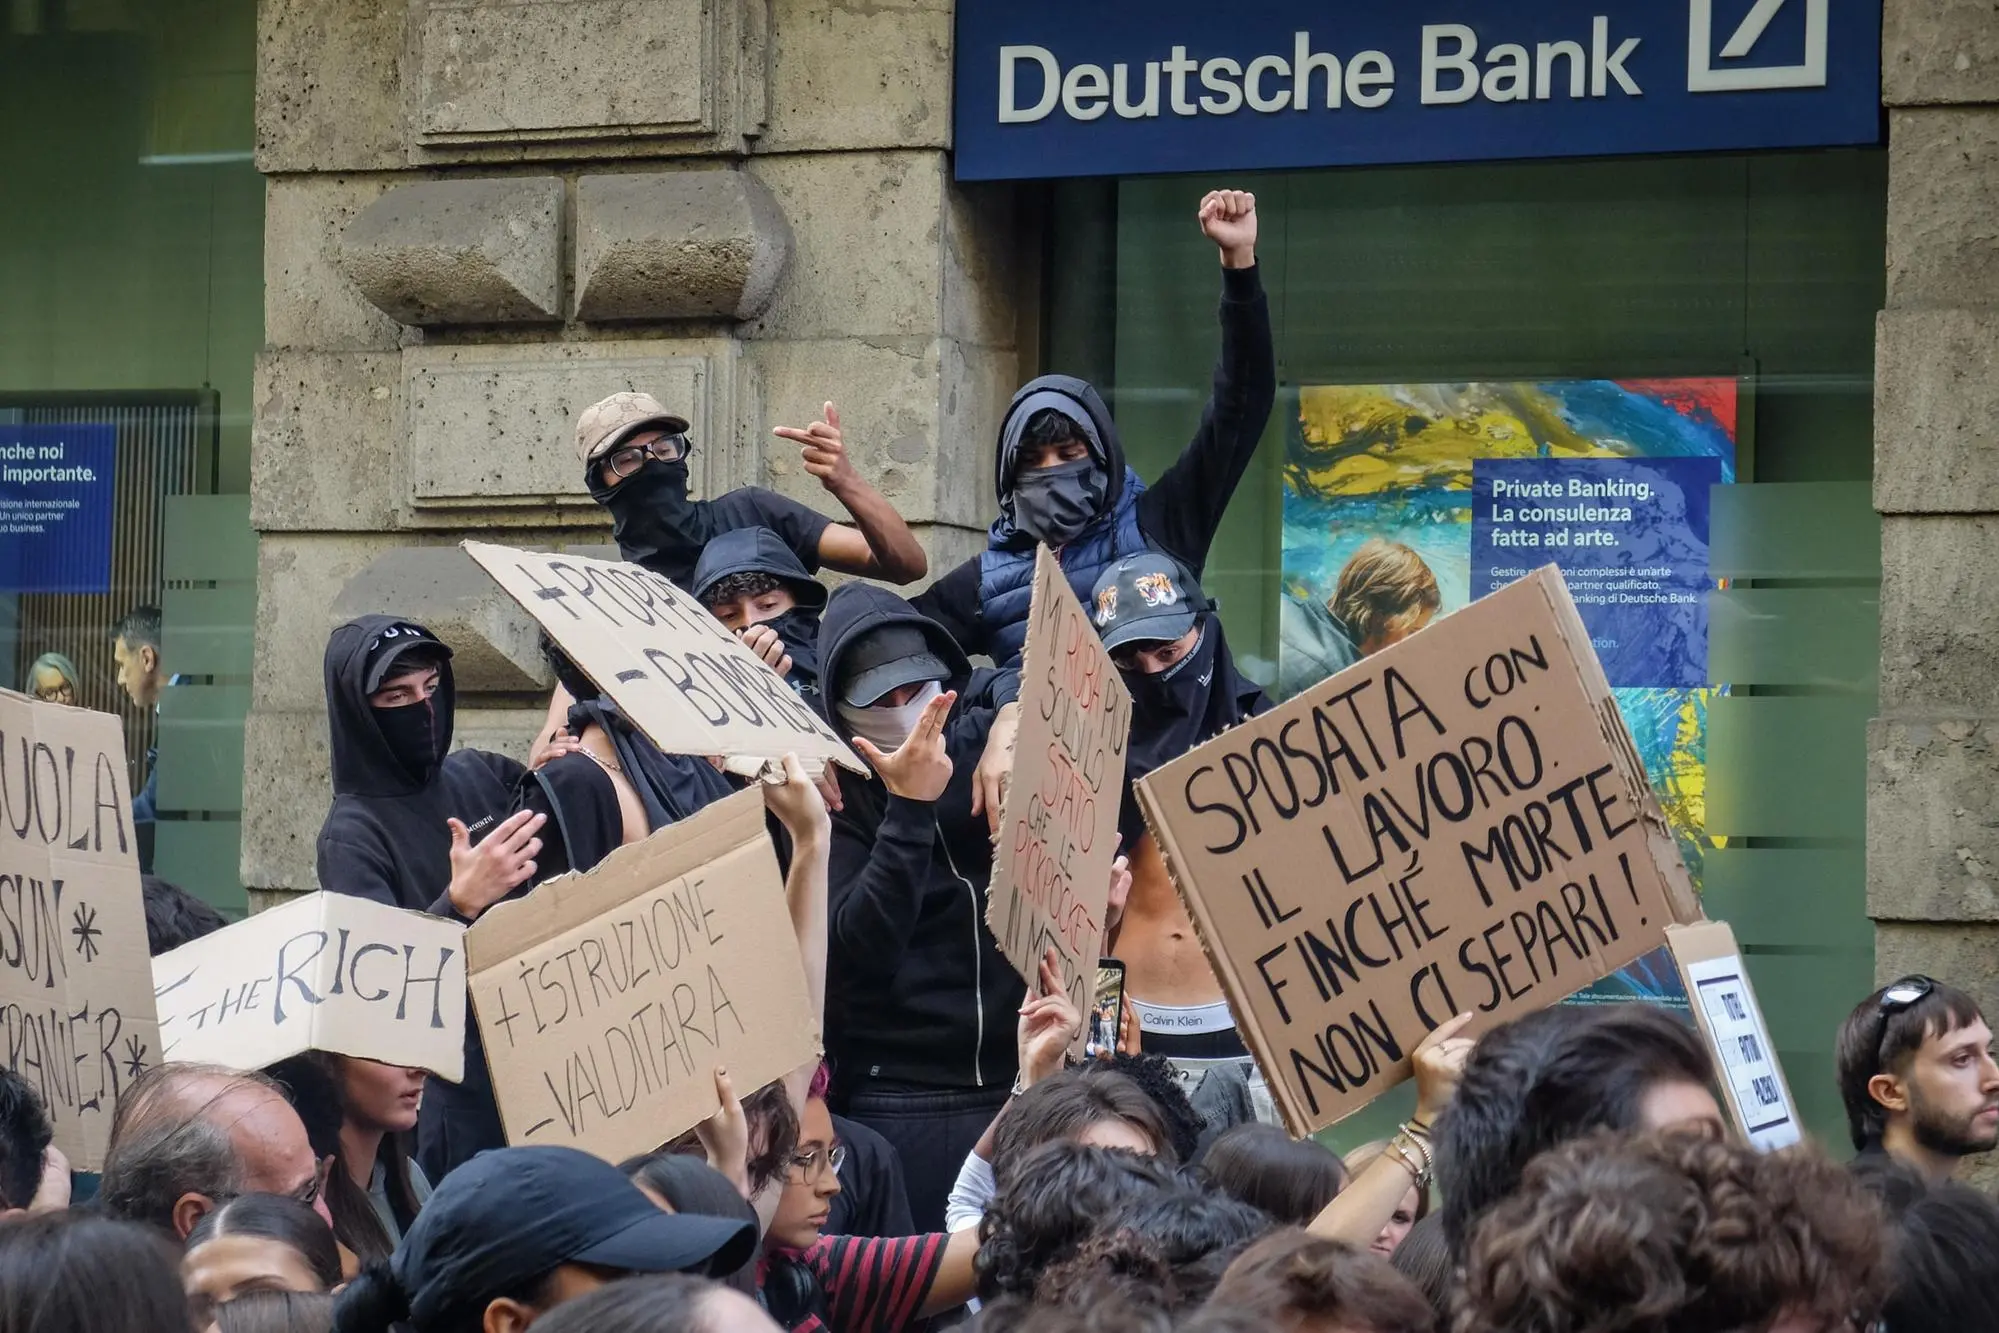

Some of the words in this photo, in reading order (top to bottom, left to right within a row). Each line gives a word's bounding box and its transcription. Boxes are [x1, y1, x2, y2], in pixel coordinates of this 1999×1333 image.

[998, 31, 1394, 123] Deutsche
[1420, 15, 1643, 105] Bank
[3, 465, 97, 485] importante.
[39, 442, 64, 460] noi
[12, 511, 34, 521] unico
[35, 512, 65, 522] partner
[25, 498, 80, 509] internazionale
[1492, 478, 1563, 498] Private
[1568, 478, 1655, 501] Banking.
[1492, 503, 1514, 522] La
[1518, 503, 1632, 522] consulenza
[1491, 528, 1540, 547] fatta
[1544, 528, 1569, 547] ad
[1573, 529, 1620, 547] arte.
[1490, 566, 1527, 577] Gestire
[1577, 566, 1628, 580] complessi
[1567, 581, 1604, 592] partner
[1606, 580, 1661, 592] qualificato.
[1607, 593, 1618, 604] di
[1619, 593, 1668, 604] Deutsche
[1670, 593, 1698, 604] Bank.
[1039, 573, 1063, 660] MI
[641, 648, 841, 744] BOMBE
[1083, 728, 1105, 794] LO
[1185, 666, 1447, 855] SPOSATA
[1464, 634, 1549, 709] CON
[0, 730, 128, 854] UOLA
[1041, 742, 1096, 853] STATO
[1027, 793, 1053, 845] CHE
[1058, 833, 1076, 881] LE
[1460, 763, 1638, 909] MORTE
[1005, 884, 1024, 955] IN
[1011, 819, 1098, 966] PICKPOCKET
[1240, 867, 1303, 930] IL
[187, 975, 273, 1030] THE
[273, 927, 455, 1028] RICH
[544, 963, 746, 1137] VALDITARA
[1143, 1012, 1175, 1026] Calvin
[1177, 1015, 1203, 1027] Klein
[1289, 999, 1404, 1116] NON
[1410, 962, 1459, 1031] CI
